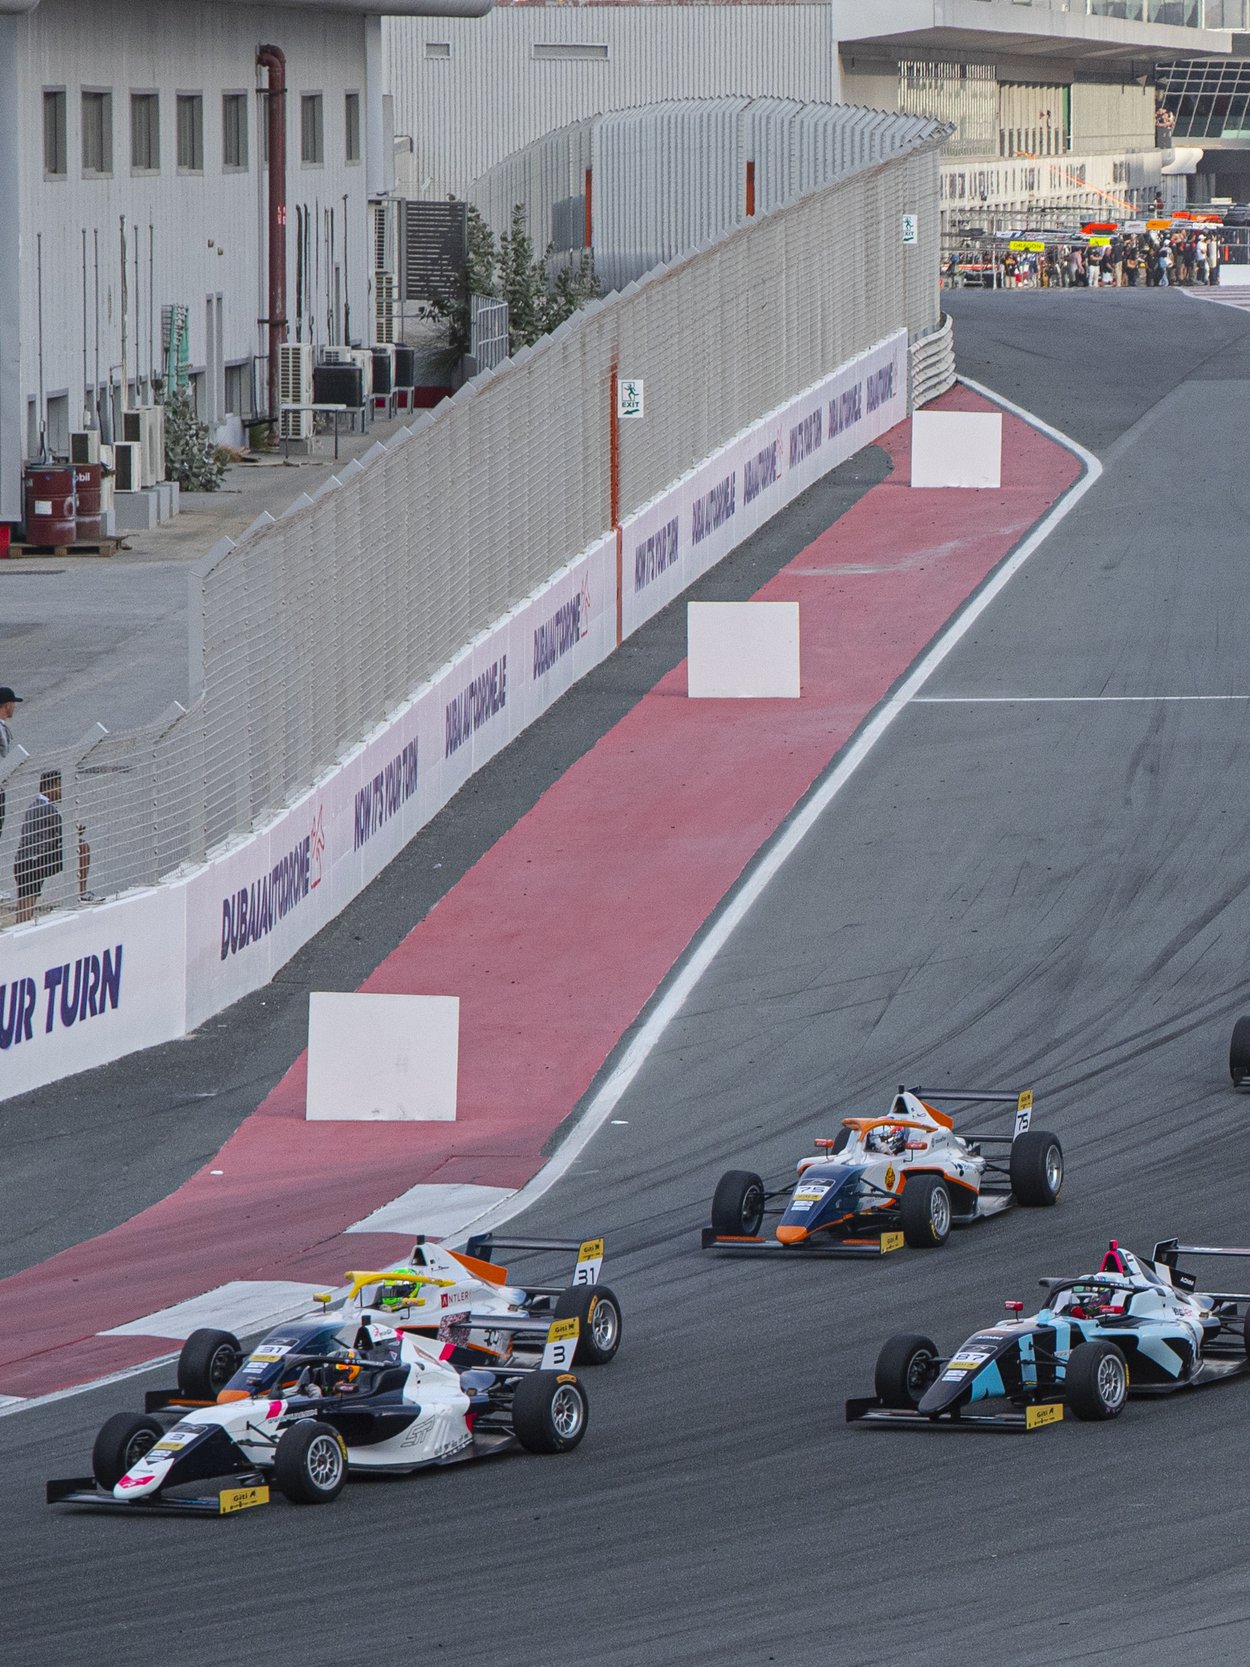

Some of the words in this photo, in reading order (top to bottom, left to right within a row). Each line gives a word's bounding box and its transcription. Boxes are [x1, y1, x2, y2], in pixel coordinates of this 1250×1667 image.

[44, 944, 123, 1034] TURN
[1017, 1112, 1029, 1131] 75
[578, 1267, 595, 1285] 31
[555, 1325, 568, 1334] Giti
[260, 1346, 283, 1354] 31
[553, 1345, 565, 1365] 3
[956, 1353, 984, 1361] 87
[172, 1433, 185, 1441] 3
[233, 1492, 248, 1502] Giti
